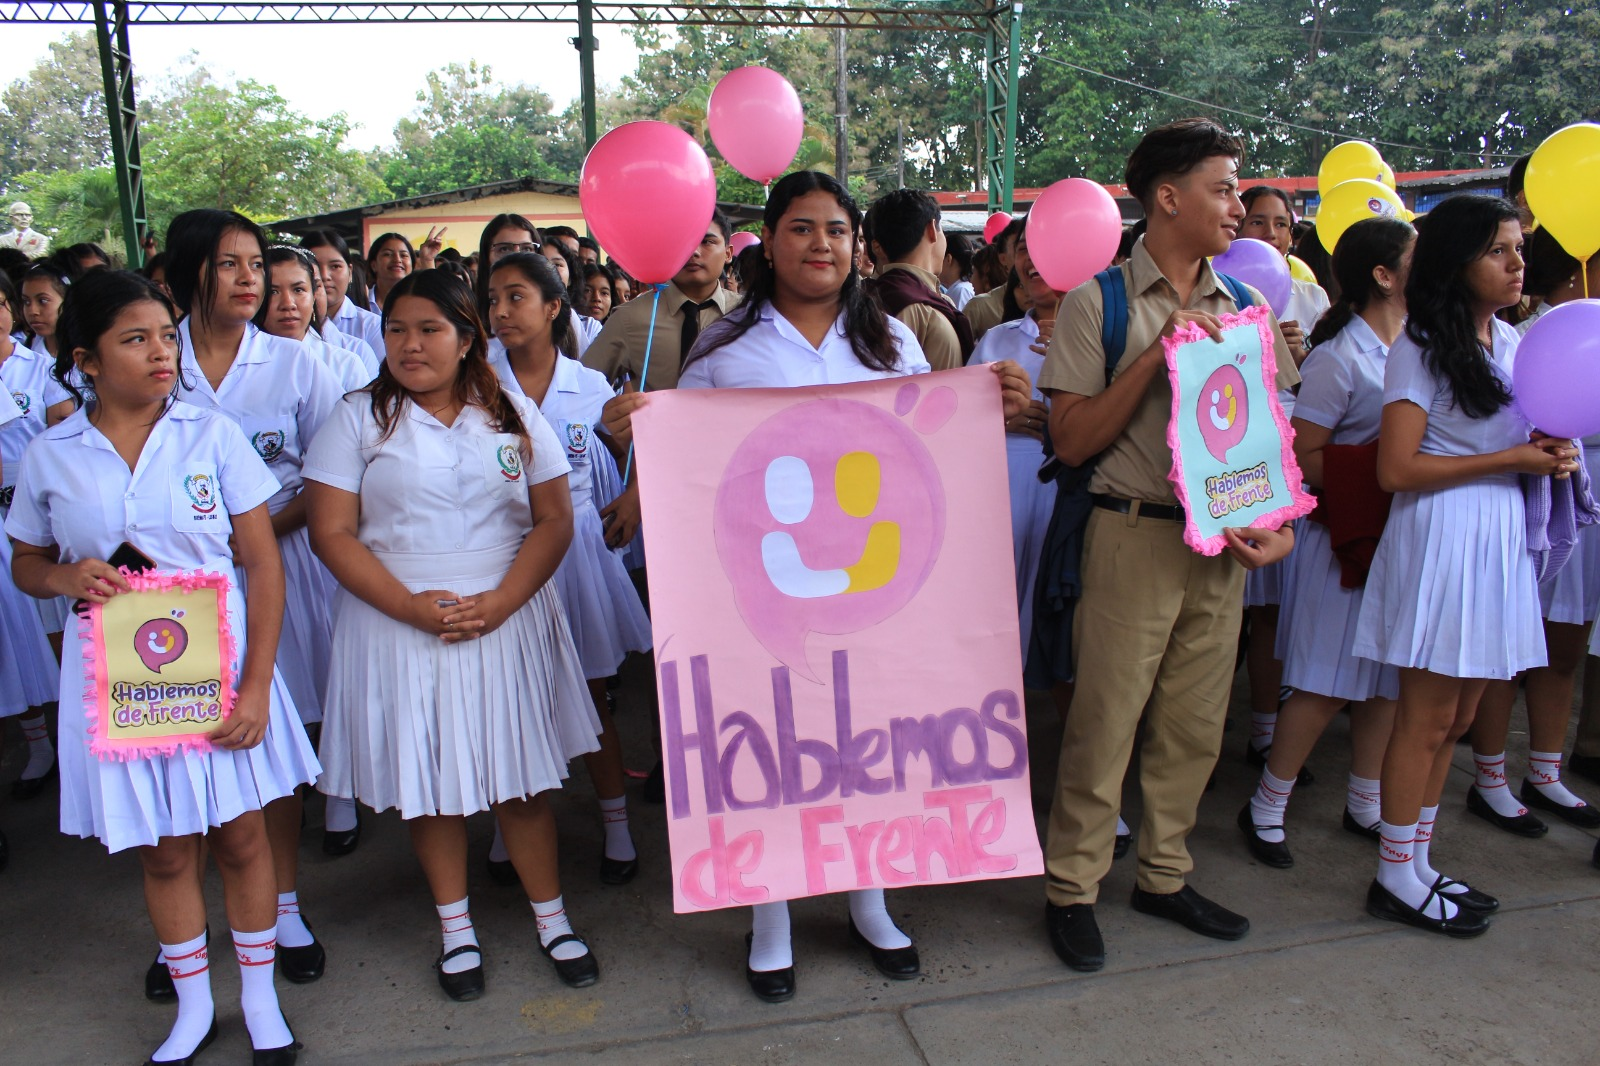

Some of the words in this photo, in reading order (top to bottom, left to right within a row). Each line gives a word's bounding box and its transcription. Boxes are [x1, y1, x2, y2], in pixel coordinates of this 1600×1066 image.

[1208, 465, 1266, 496] Hablemos
[1211, 498, 1226, 515] de
[1228, 483, 1270, 509] Frente
[117, 682, 218, 702] Hablemos
[117, 704, 142, 723] de
[148, 700, 218, 721] Frente
[660, 649, 1028, 820] Hablemos
[680, 816, 770, 908] de
[800, 785, 1018, 895] Frente
